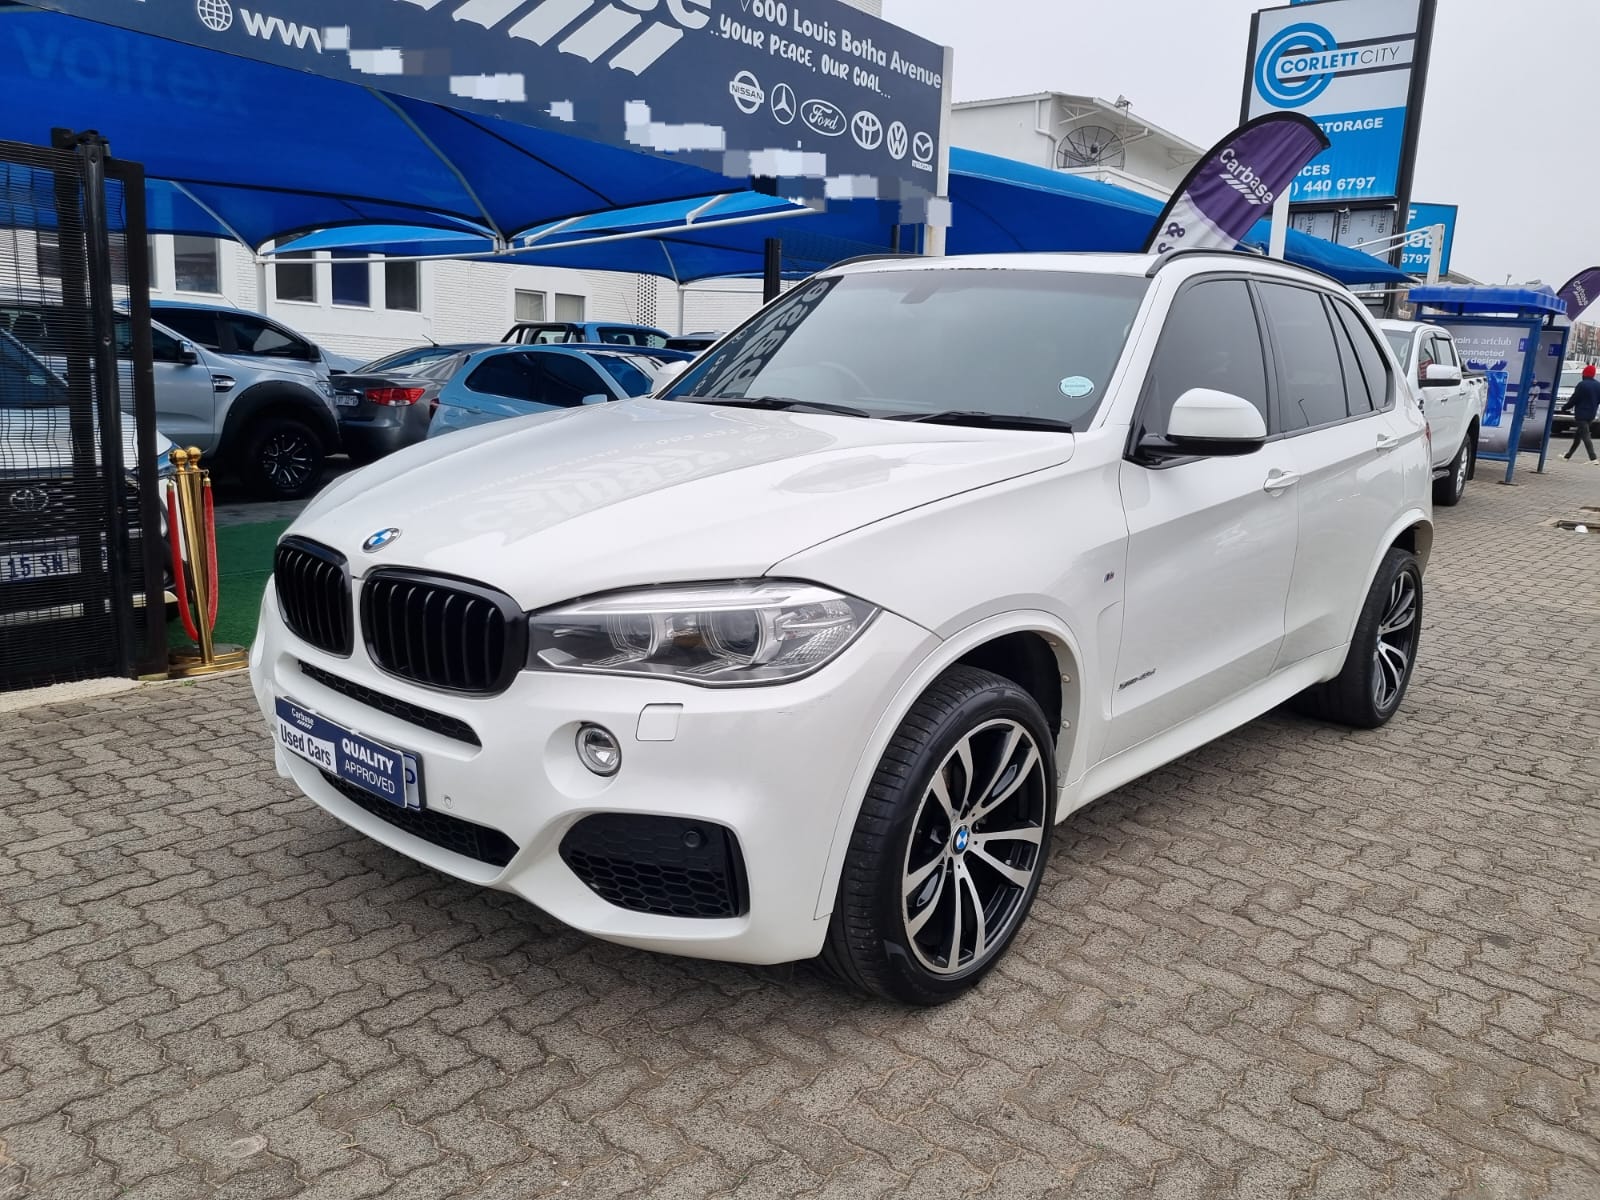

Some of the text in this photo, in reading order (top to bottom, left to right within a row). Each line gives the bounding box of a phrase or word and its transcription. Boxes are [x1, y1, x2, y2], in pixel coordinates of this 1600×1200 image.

[752, 0, 788, 27] 600
[793, 8, 837, 47] Louis
[841, 29, 886, 67] Botha
[890, 50, 942, 88] Avenue
[821, 54, 850, 81] OUR
[731, 84, 763, 101] NISSAN
[809, 104, 839, 130] Ford
[1220, 148, 1274, 204] Carbase
[1303, 180, 1331, 193] 440
[1337, 177, 1376, 191] 6797
[291, 707, 314, 725] Carbase
[280, 723, 331, 766] Used Cars
[342, 737, 394, 775] QUALITY
[344, 760, 396, 795] APPROVED
